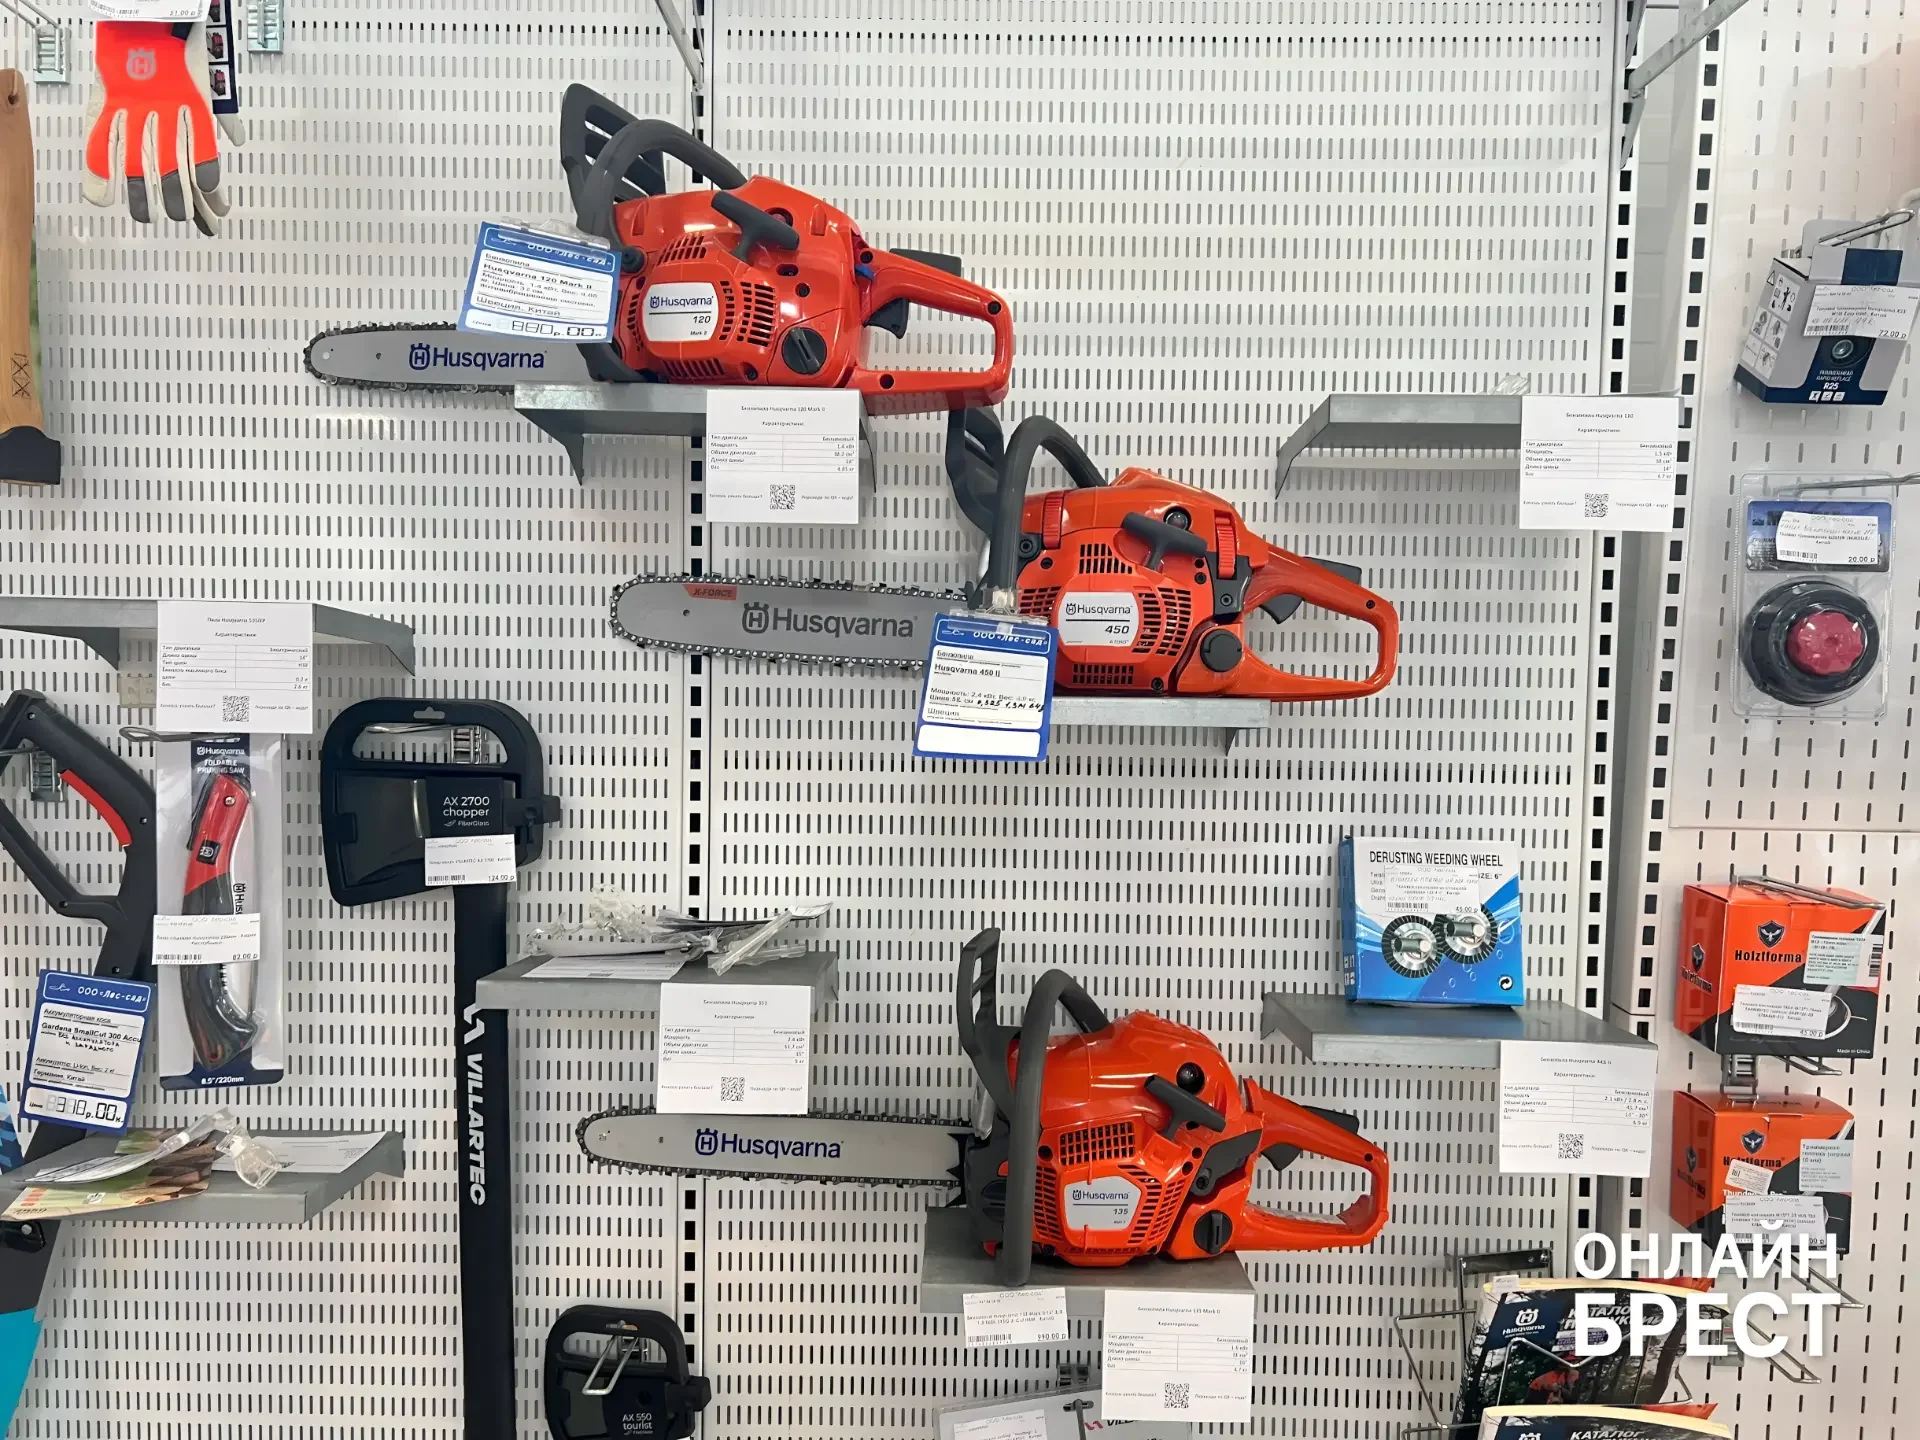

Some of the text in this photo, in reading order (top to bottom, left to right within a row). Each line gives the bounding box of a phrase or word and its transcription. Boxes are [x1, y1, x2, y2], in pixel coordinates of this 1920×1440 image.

[484, 263, 537, 280] Husqvarna
[541, 275, 557, 284] 120
[560, 279, 583, 289] Mark
[661, 297, 712, 307] Husqvarna
[693, 316, 710, 324] 120
[434, 348, 544, 371] Husqvarna
[693, 588, 733, 598] X-FORCE
[1077, 604, 1131, 615] Husqvarna
[773, 608, 915, 638] Husqvarna
[973, 631, 995, 639] ООО
[1105, 626, 1129, 634] 450
[934, 664, 978, 675] Husqvarna
[206, 747, 244, 755] Husqvarna
[443, 796, 490, 806] AX 2700
[443, 808, 489, 818] chopper
[1370, 851, 1503, 867] DERUSTING WEEDING WHEEL
[1735, 950, 1801, 963] Holzfforma
[78, 986, 98, 996] ООО
[42, 1023, 72, 1032] Gardena
[74, 1027, 107, 1038] SmallCut
[467, 1053, 486, 1206] VILLARTEC
[721, 1133, 841, 1159] Husqvarna
[1083, 1191, 1128, 1200] Husqvarna
[1503, 1325, 1545, 1335] Husqvarna
[622, 1413, 652, 1422] AX 550
[623, 1421, 652, 1430] tourist
[1571, 1430, 1645, 1439] КАТАЛОГ
